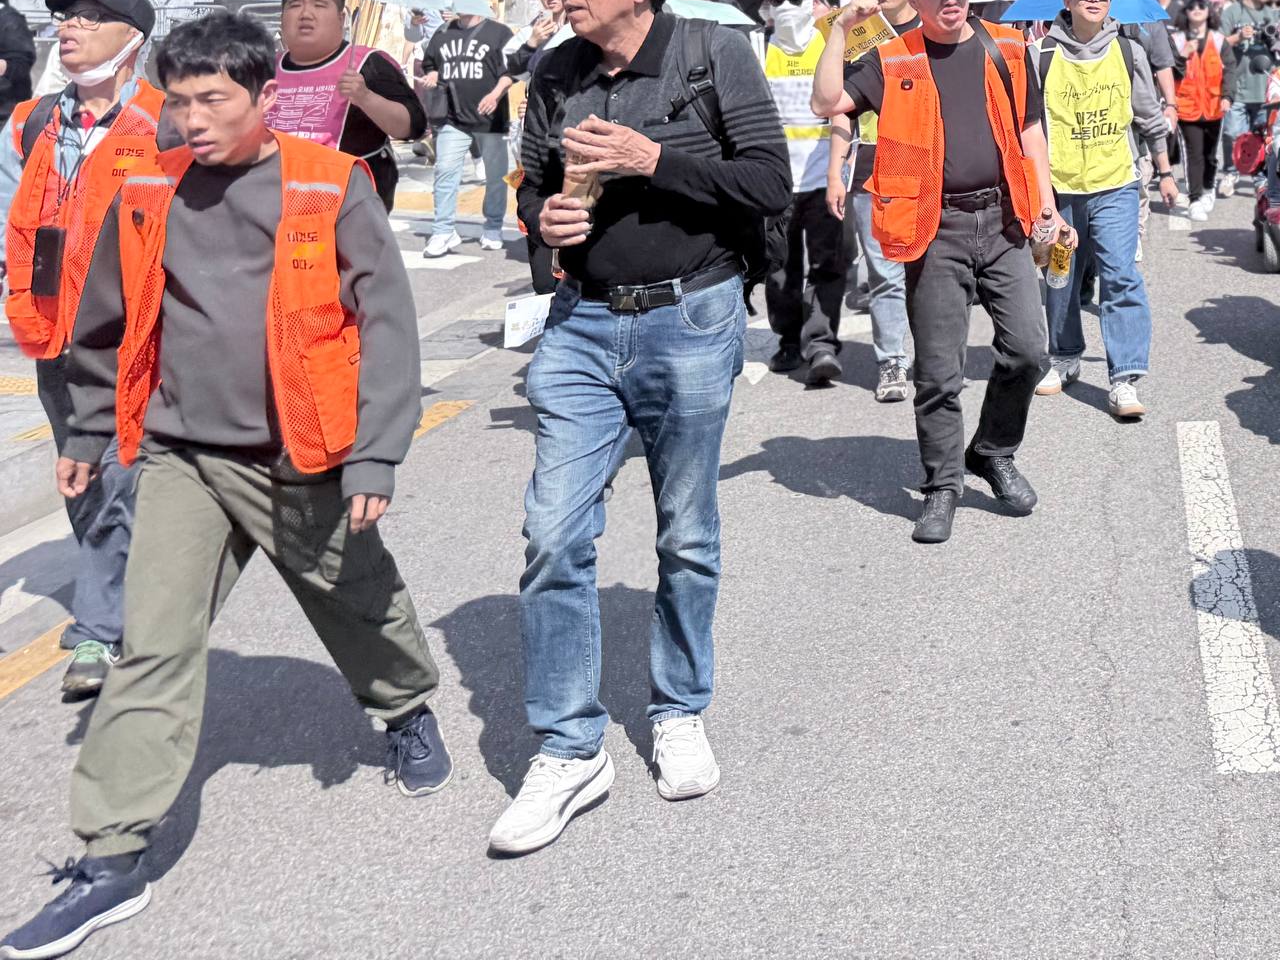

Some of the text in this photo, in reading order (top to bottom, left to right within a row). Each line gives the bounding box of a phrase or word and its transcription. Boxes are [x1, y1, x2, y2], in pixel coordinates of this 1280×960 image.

[439, 38, 490, 61] MILES
[443, 61, 483, 80] DAVIS
[1076, 108, 1109, 126] 이것도
